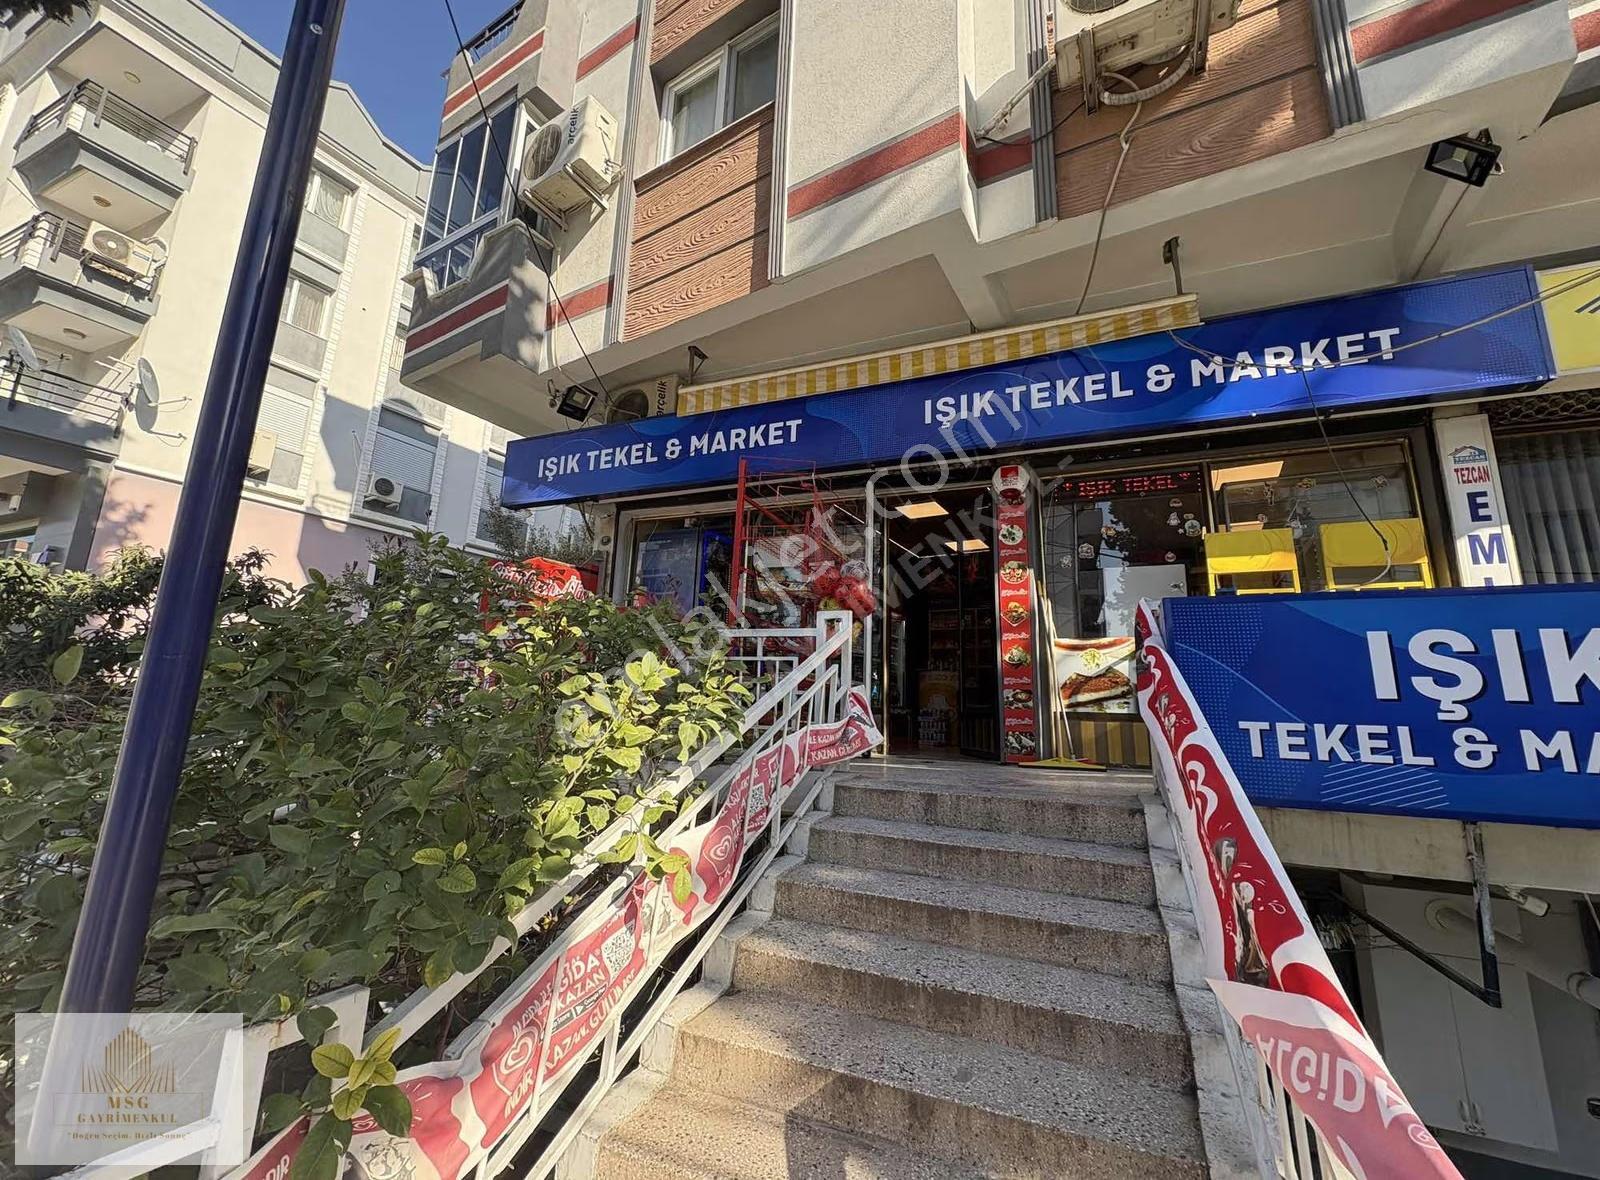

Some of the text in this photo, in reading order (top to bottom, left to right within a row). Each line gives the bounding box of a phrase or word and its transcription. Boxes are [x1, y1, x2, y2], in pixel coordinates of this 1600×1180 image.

[924, 327, 1400, 428] IŞIK TEKEL & MARKET
[538, 419, 802, 482] IŞIK TEKEL & MARKET
[1454, 465, 1490, 485] TEZCAN
[1366, 628, 1600, 721] IŞIK
[1238, 721, 1435, 766] TEKEL
[1452, 727, 1498, 768] &
